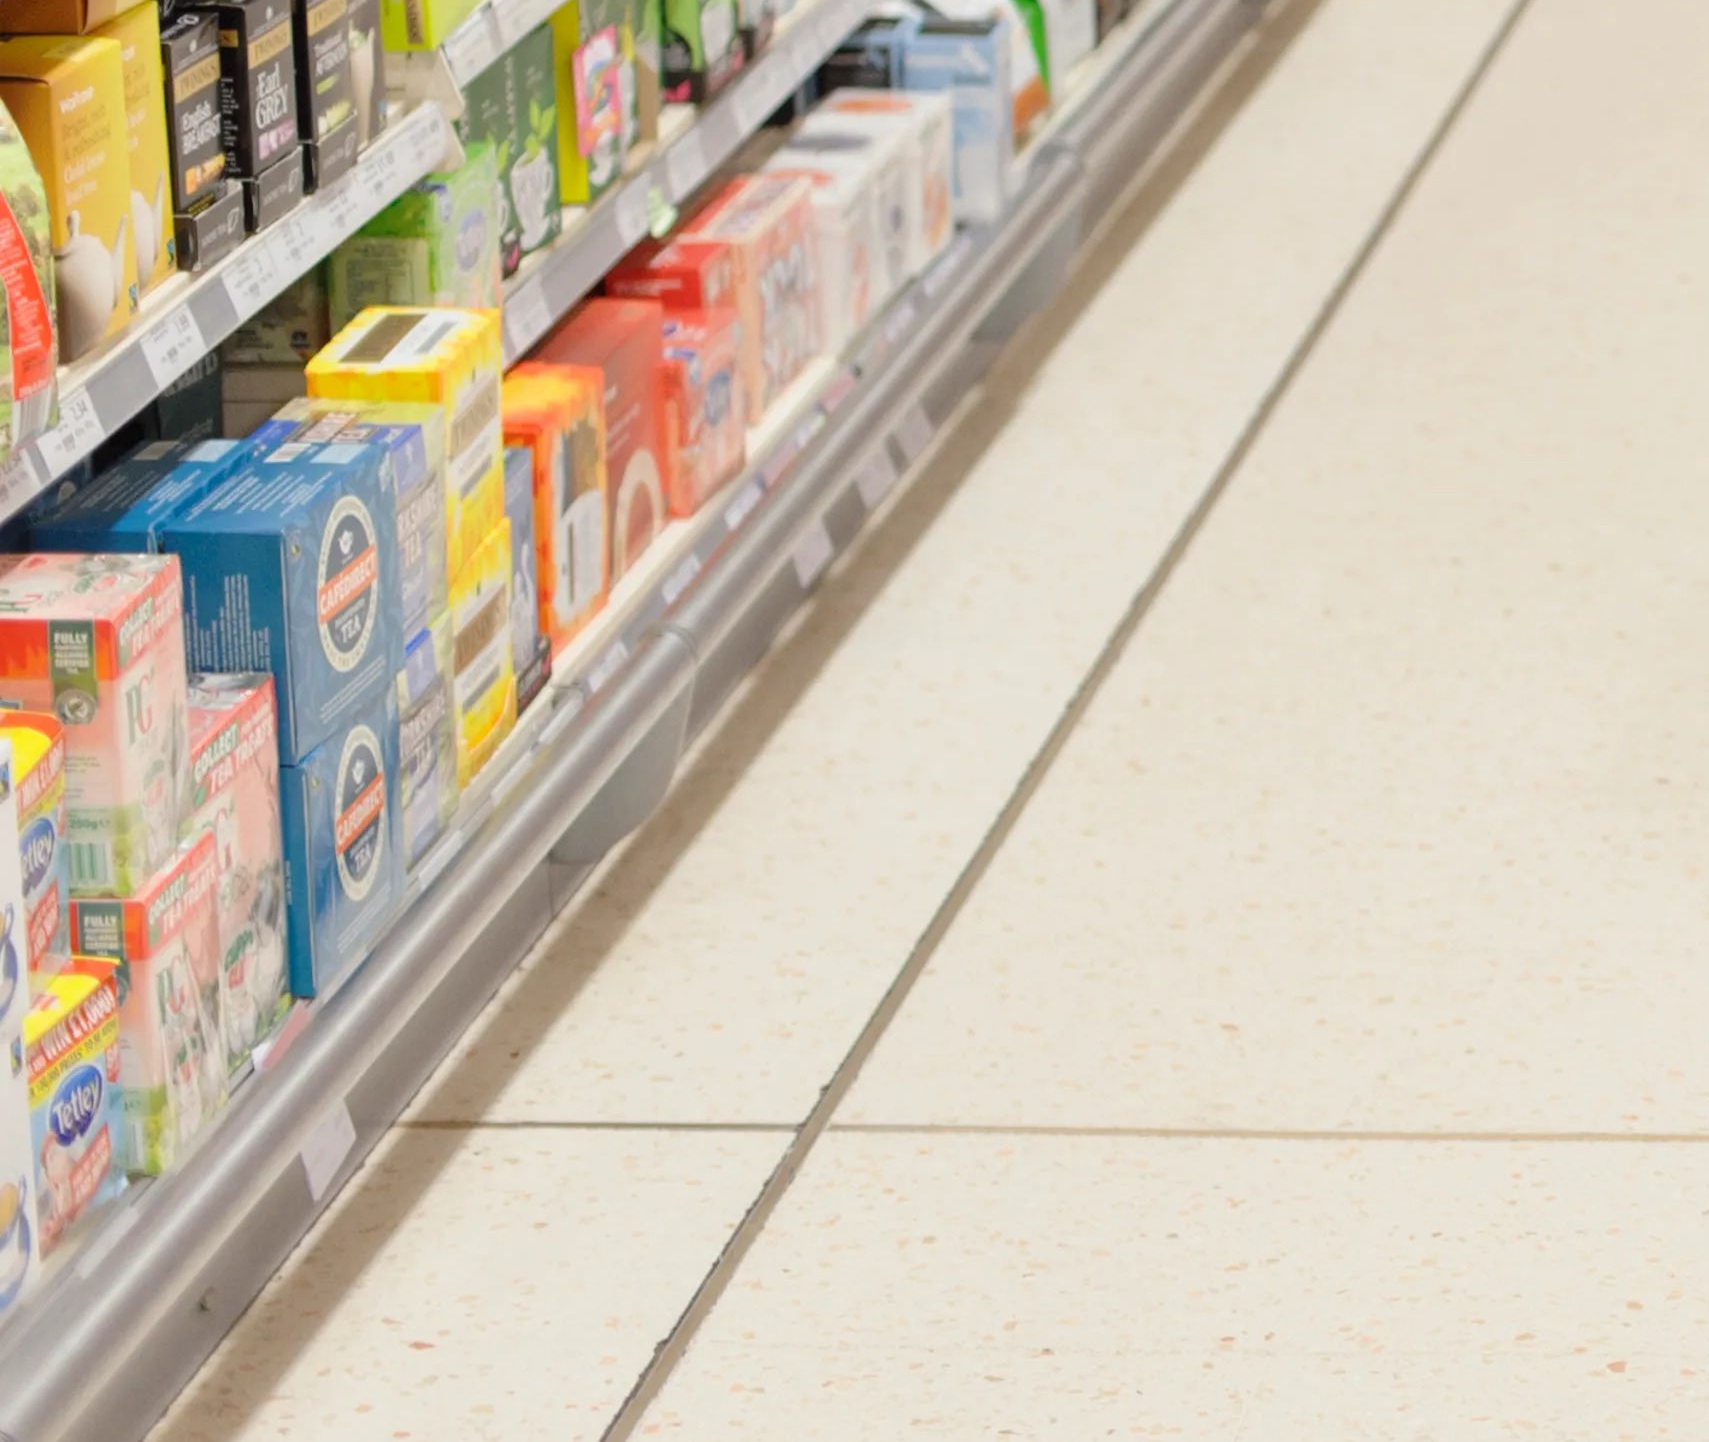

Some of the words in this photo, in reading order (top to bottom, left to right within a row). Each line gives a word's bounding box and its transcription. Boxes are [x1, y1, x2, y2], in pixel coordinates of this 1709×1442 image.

[257, 62, 281, 100] Earl
[182, 99, 212, 134] English
[255, 84, 290, 129] GREY
[320, 547, 377, 615] CAFÉDIRECT
[54, 633, 88, 644] FULLY
[119, 598, 154, 648] COLLECT
[340, 617, 361, 645] TEA
[194, 723, 239, 778] COLLECT
[211, 752, 235, 795] TEA
[336, 779, 384, 846] CAFÉDIRECT
[23, 827, 52, 879] etley
[353, 848, 371, 874] TEA
[84, 915, 117, 927] FULLY
[41, 1016, 69, 1062] WIN
[53, 1072, 99, 1135] Tetley
